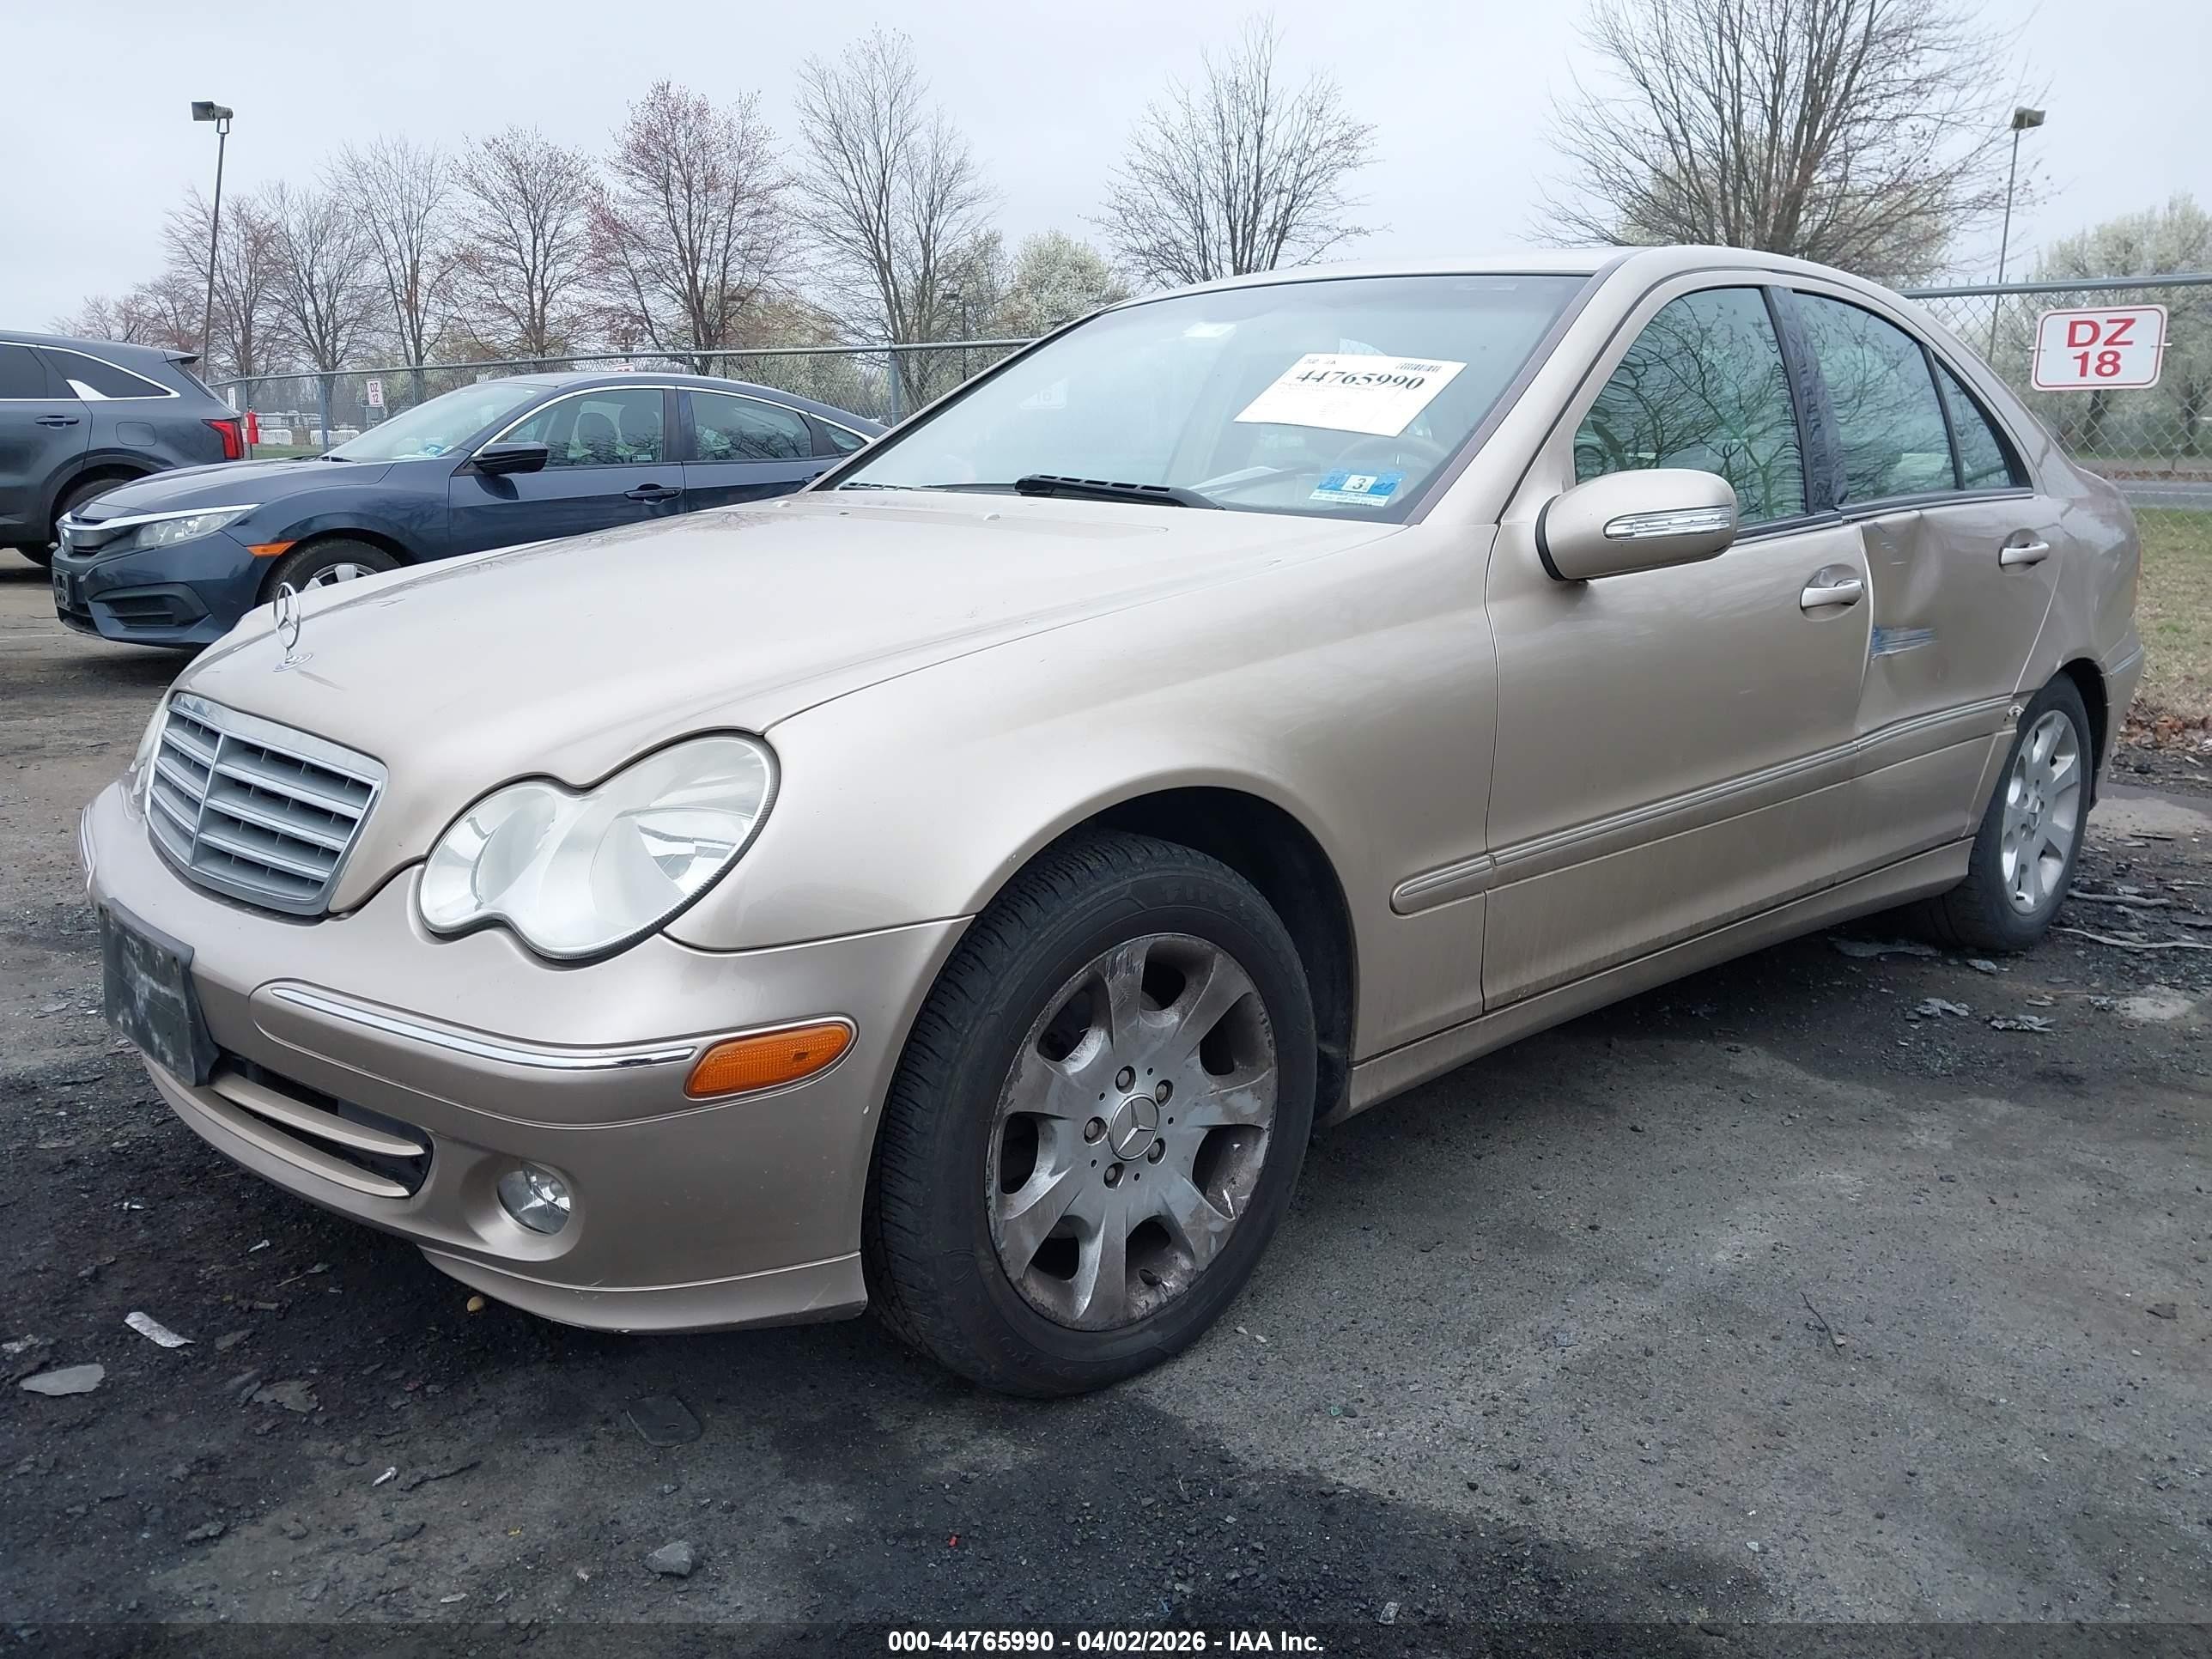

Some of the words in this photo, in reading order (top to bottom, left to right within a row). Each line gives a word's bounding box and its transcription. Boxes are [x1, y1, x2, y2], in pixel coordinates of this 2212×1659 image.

[2068, 319, 2136, 348] DZ
[2073, 350, 2121, 378] 18
[370, 382, 379, 392] DZ
[1295, 369, 1425, 390] 44765990
[373, 393, 380, 404] 12
[1352, 477, 1367, 489] 3
